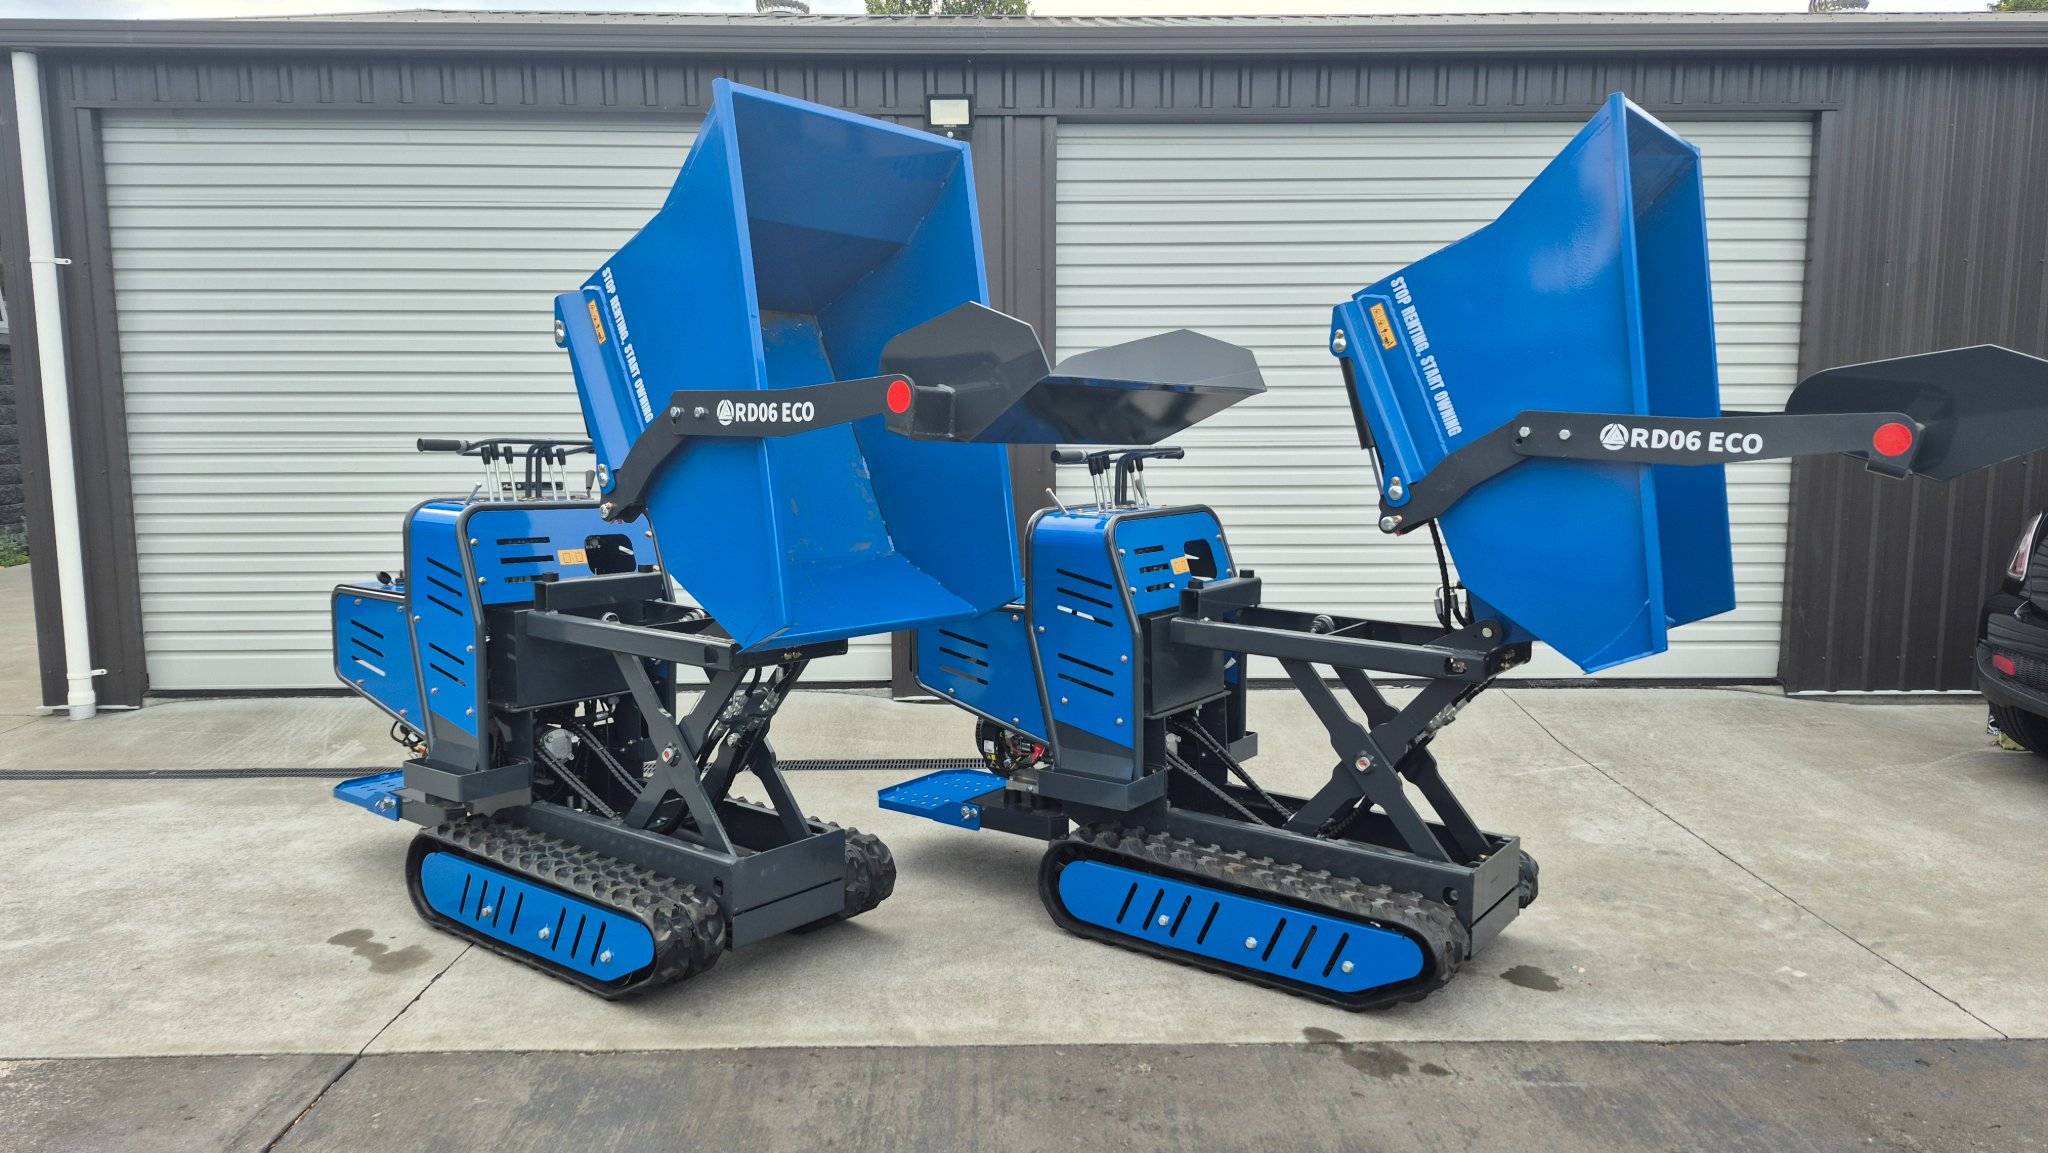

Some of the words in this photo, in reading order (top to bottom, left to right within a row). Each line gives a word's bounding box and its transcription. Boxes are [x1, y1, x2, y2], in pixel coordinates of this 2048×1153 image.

[602, 267, 616, 294] STOP
[610, 295, 629, 345] RENTING,
[624, 343, 640, 378] START
[634, 378, 654, 424] OWNING
[1390, 276, 1412, 305] STOP
[1401, 305, 1430, 357] RENTING,
[1420, 354, 1445, 391] START
[1434, 390, 1462, 438] OWNING
[735, 402, 778, 423] RD06
[782, 401, 815, 422] ECO
[1630, 427, 1702, 451] RD06
[1708, 431, 1763, 454] ECO
